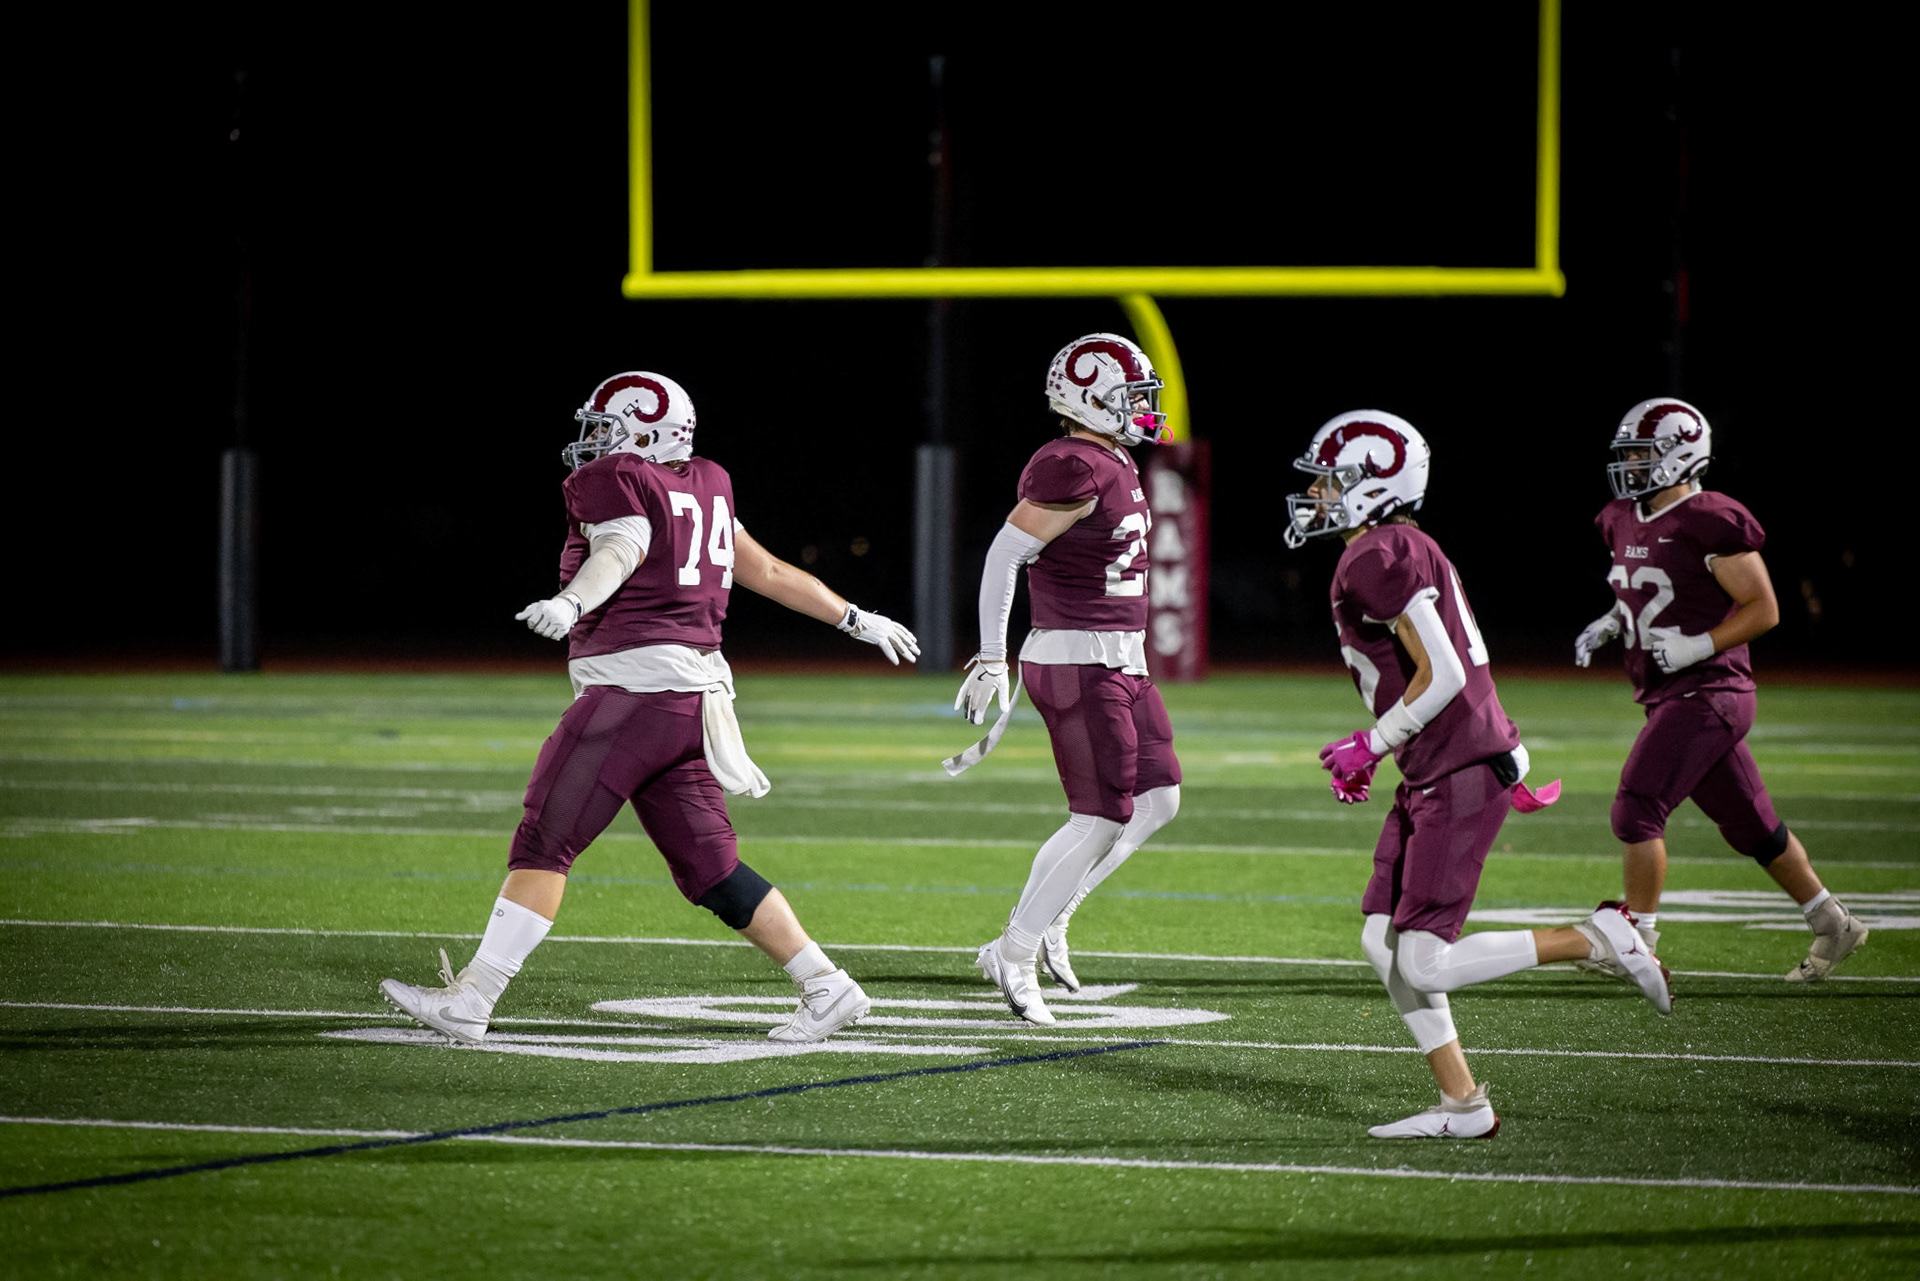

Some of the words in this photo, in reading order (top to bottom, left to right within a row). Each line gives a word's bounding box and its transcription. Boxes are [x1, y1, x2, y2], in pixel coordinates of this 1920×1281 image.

[668, 491, 734, 589] 74
[1105, 508, 1152, 597] 2
[1624, 545, 1649, 559] RAMS
